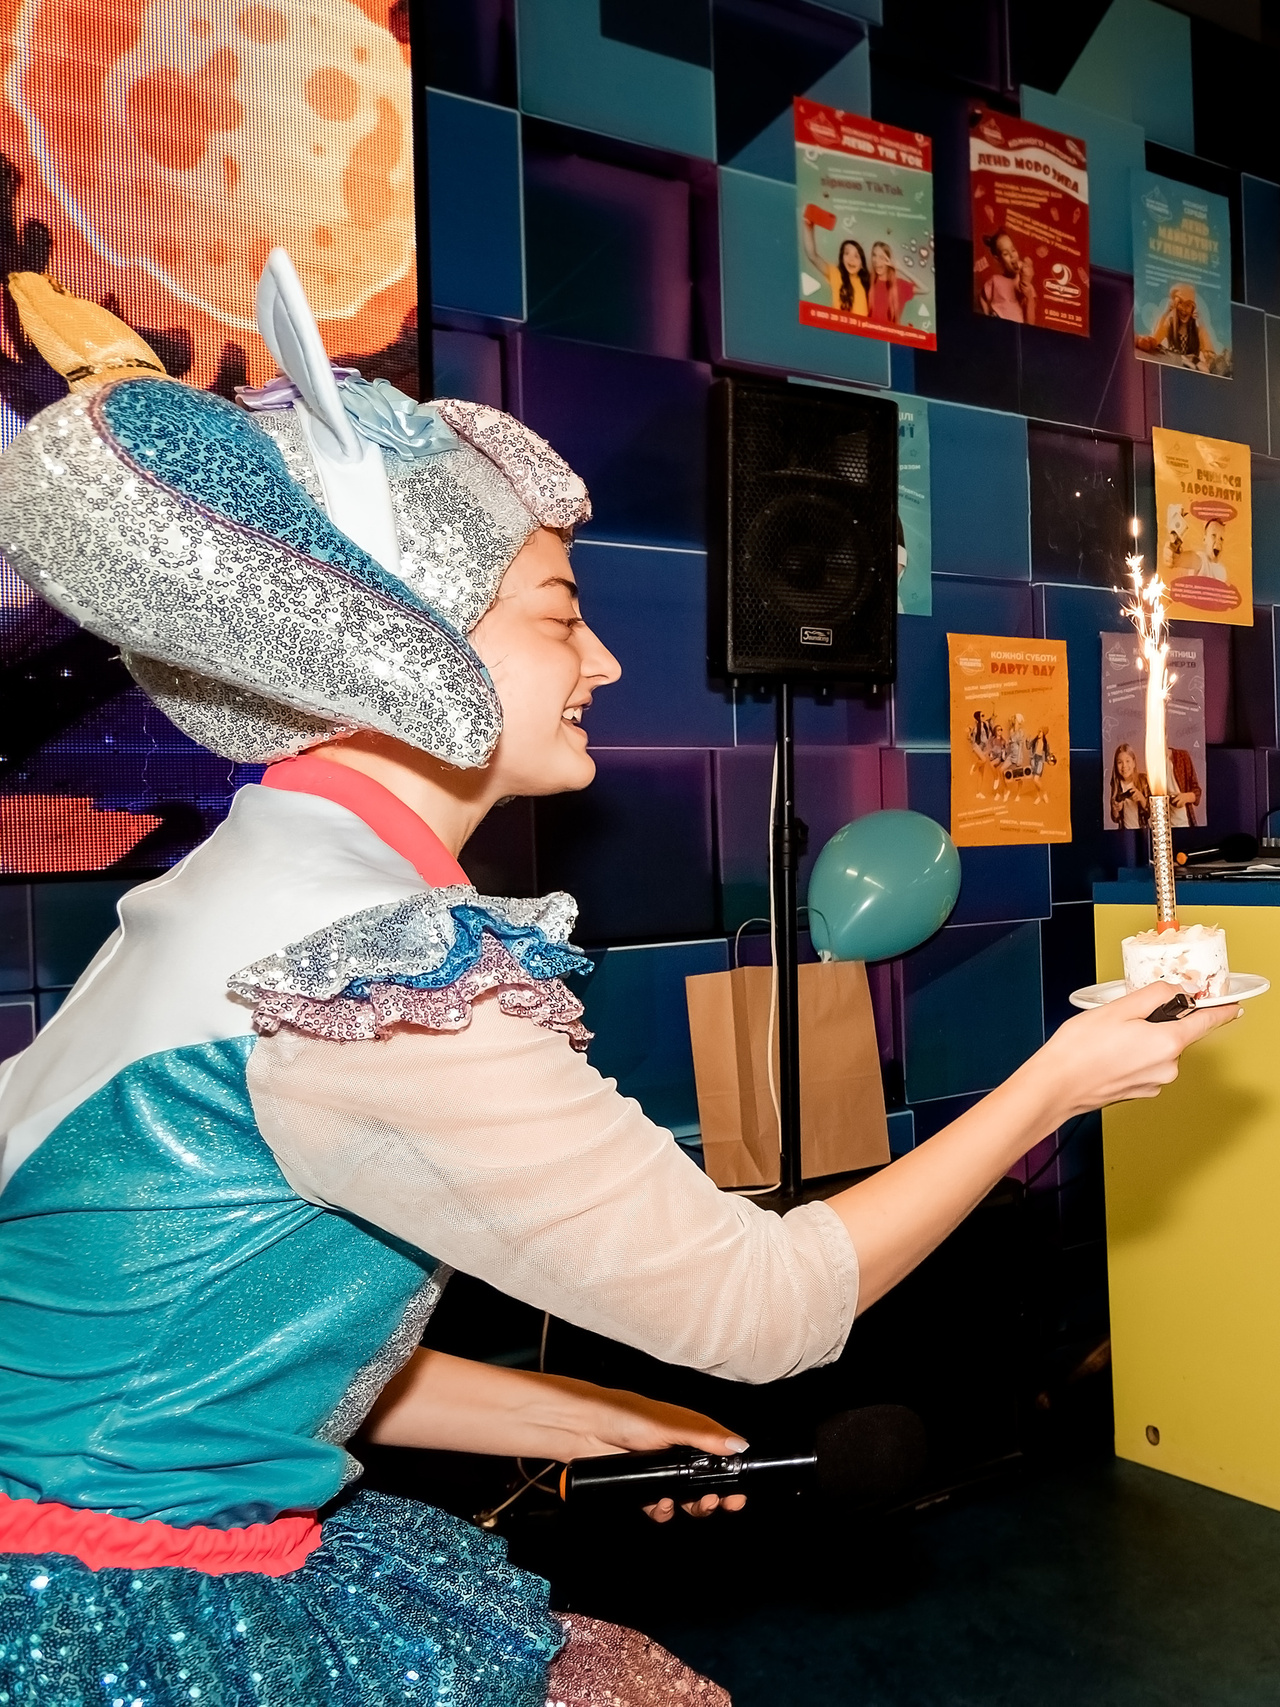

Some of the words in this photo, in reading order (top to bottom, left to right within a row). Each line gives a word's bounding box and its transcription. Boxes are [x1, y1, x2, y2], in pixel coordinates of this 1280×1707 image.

[978, 153, 1011, 168] ДЕНЬ
[1014, 156, 1080, 193] МОРОЗИВА
[1180, 481, 1243, 502] ЗАРОБЛЯТИ
[990, 651, 1024, 660] КОЖНОЇ
[1025, 653, 1057, 662] СУБОТИ
[990, 662, 1030, 676] PARTY
[1032, 664, 1056, 677] DAY
